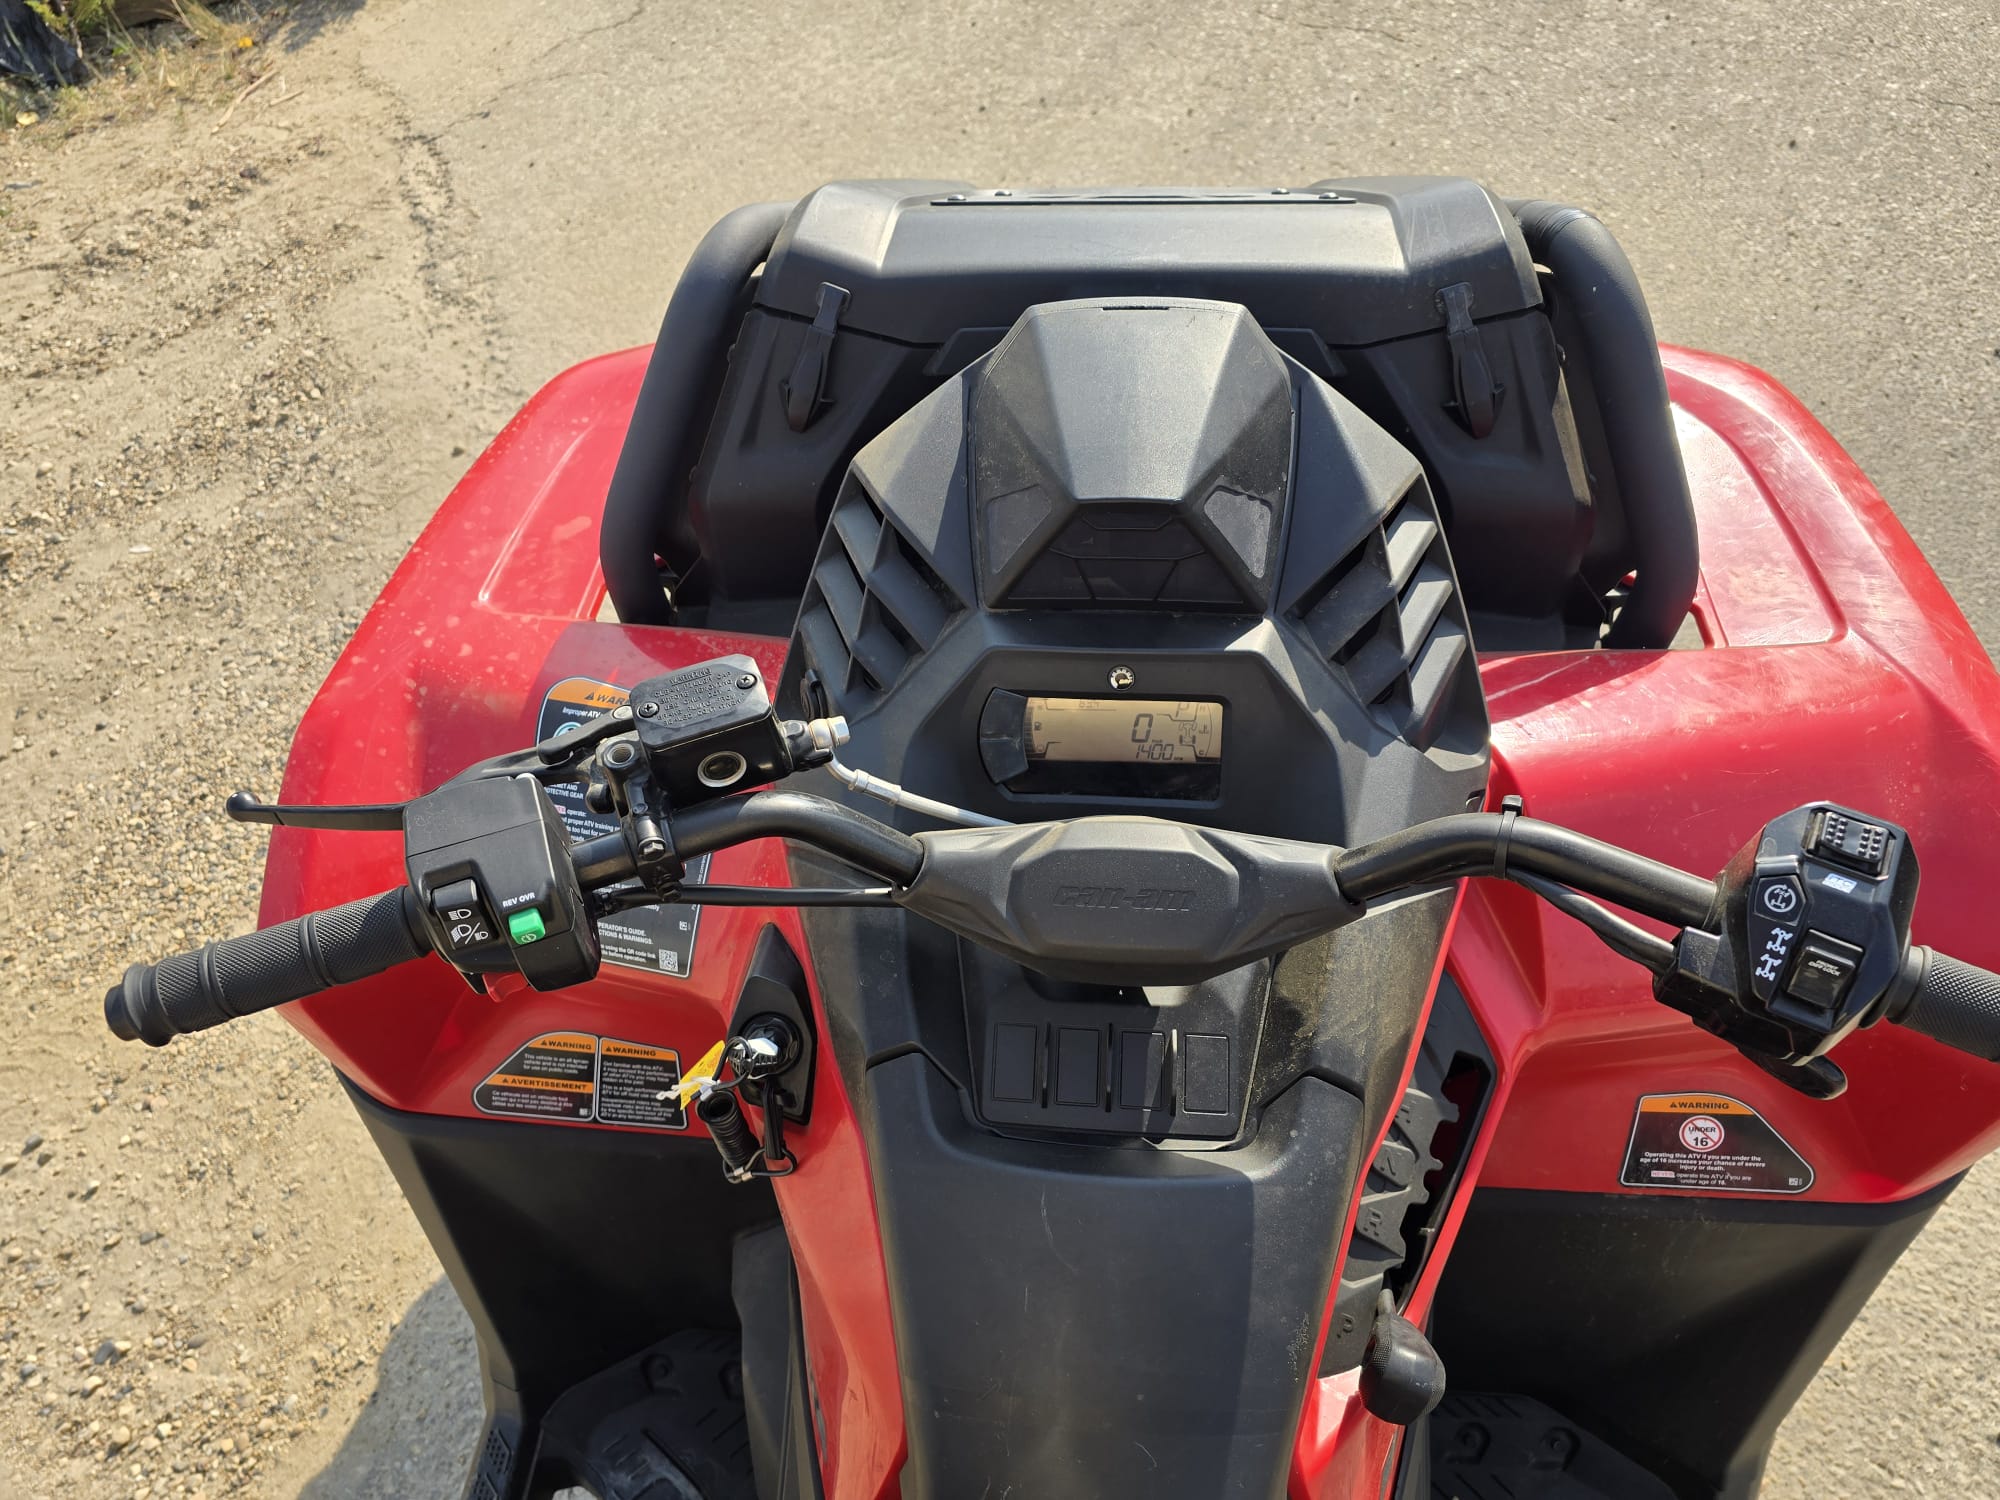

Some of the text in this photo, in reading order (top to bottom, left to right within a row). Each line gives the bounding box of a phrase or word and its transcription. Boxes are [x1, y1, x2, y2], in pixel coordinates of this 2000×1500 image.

[1131, 713, 1153, 743] 0
[1136, 744, 1174, 760] 1400
[502, 892, 536, 907] REV OVR
[598, 922, 627, 932] PERATOR'S
[548, 1040, 592, 1050] WARNING
[612, 1046, 656, 1056] WARNING
[511, 1078, 586, 1090] AVERTISSEMENT
[1678, 1102, 1730, 1110] WARNING
[1694, 1137, 1708, 1146] 16
